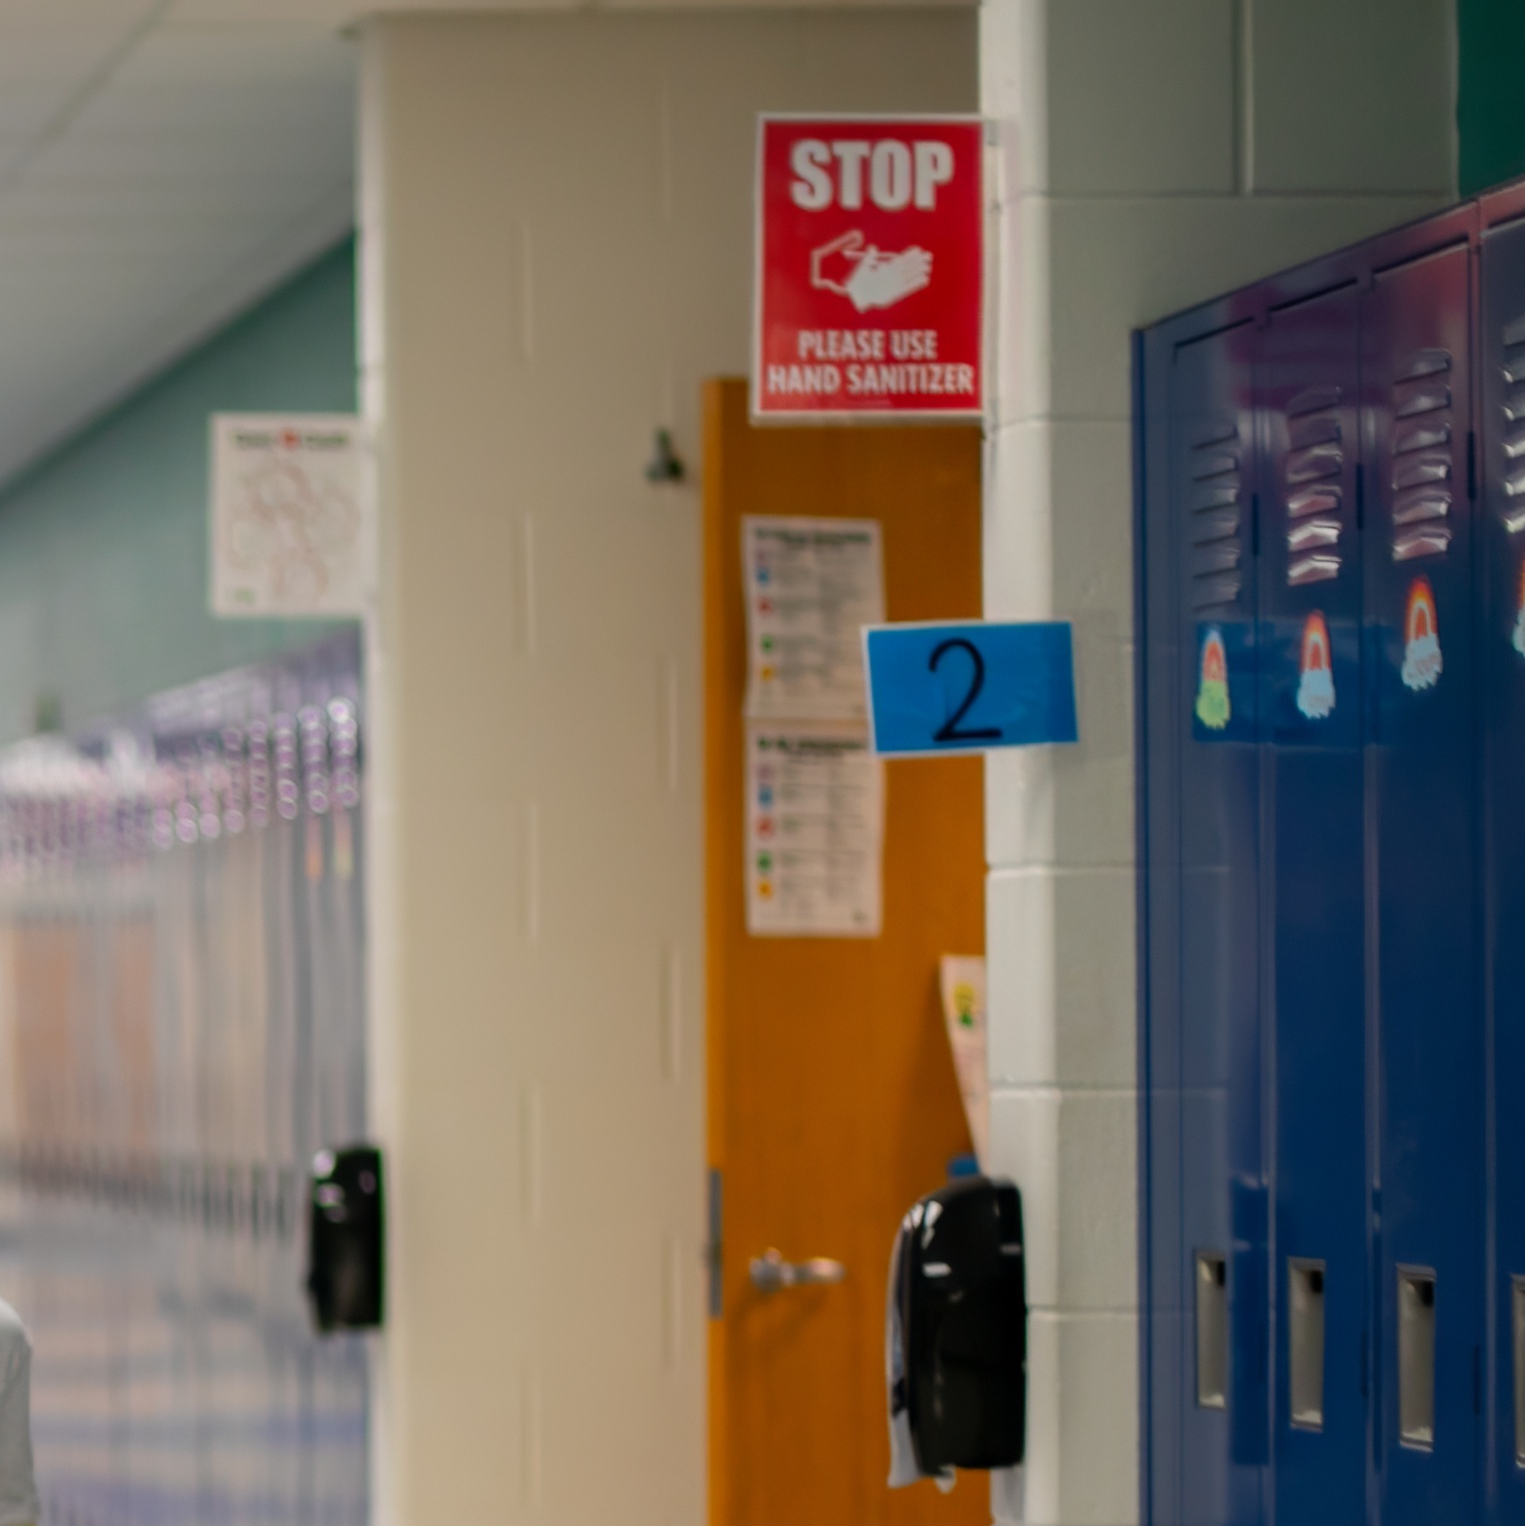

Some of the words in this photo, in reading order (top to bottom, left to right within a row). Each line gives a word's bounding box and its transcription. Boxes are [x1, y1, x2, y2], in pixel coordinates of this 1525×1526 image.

[790, 138, 955, 212] STOP
[798, 329, 884, 361] PLEASE
[890, 329, 938, 361] USE
[767, 364, 841, 394] HAND
[847, 363, 975, 395] SANITIZER
[928, 637, 1004, 742] 2
